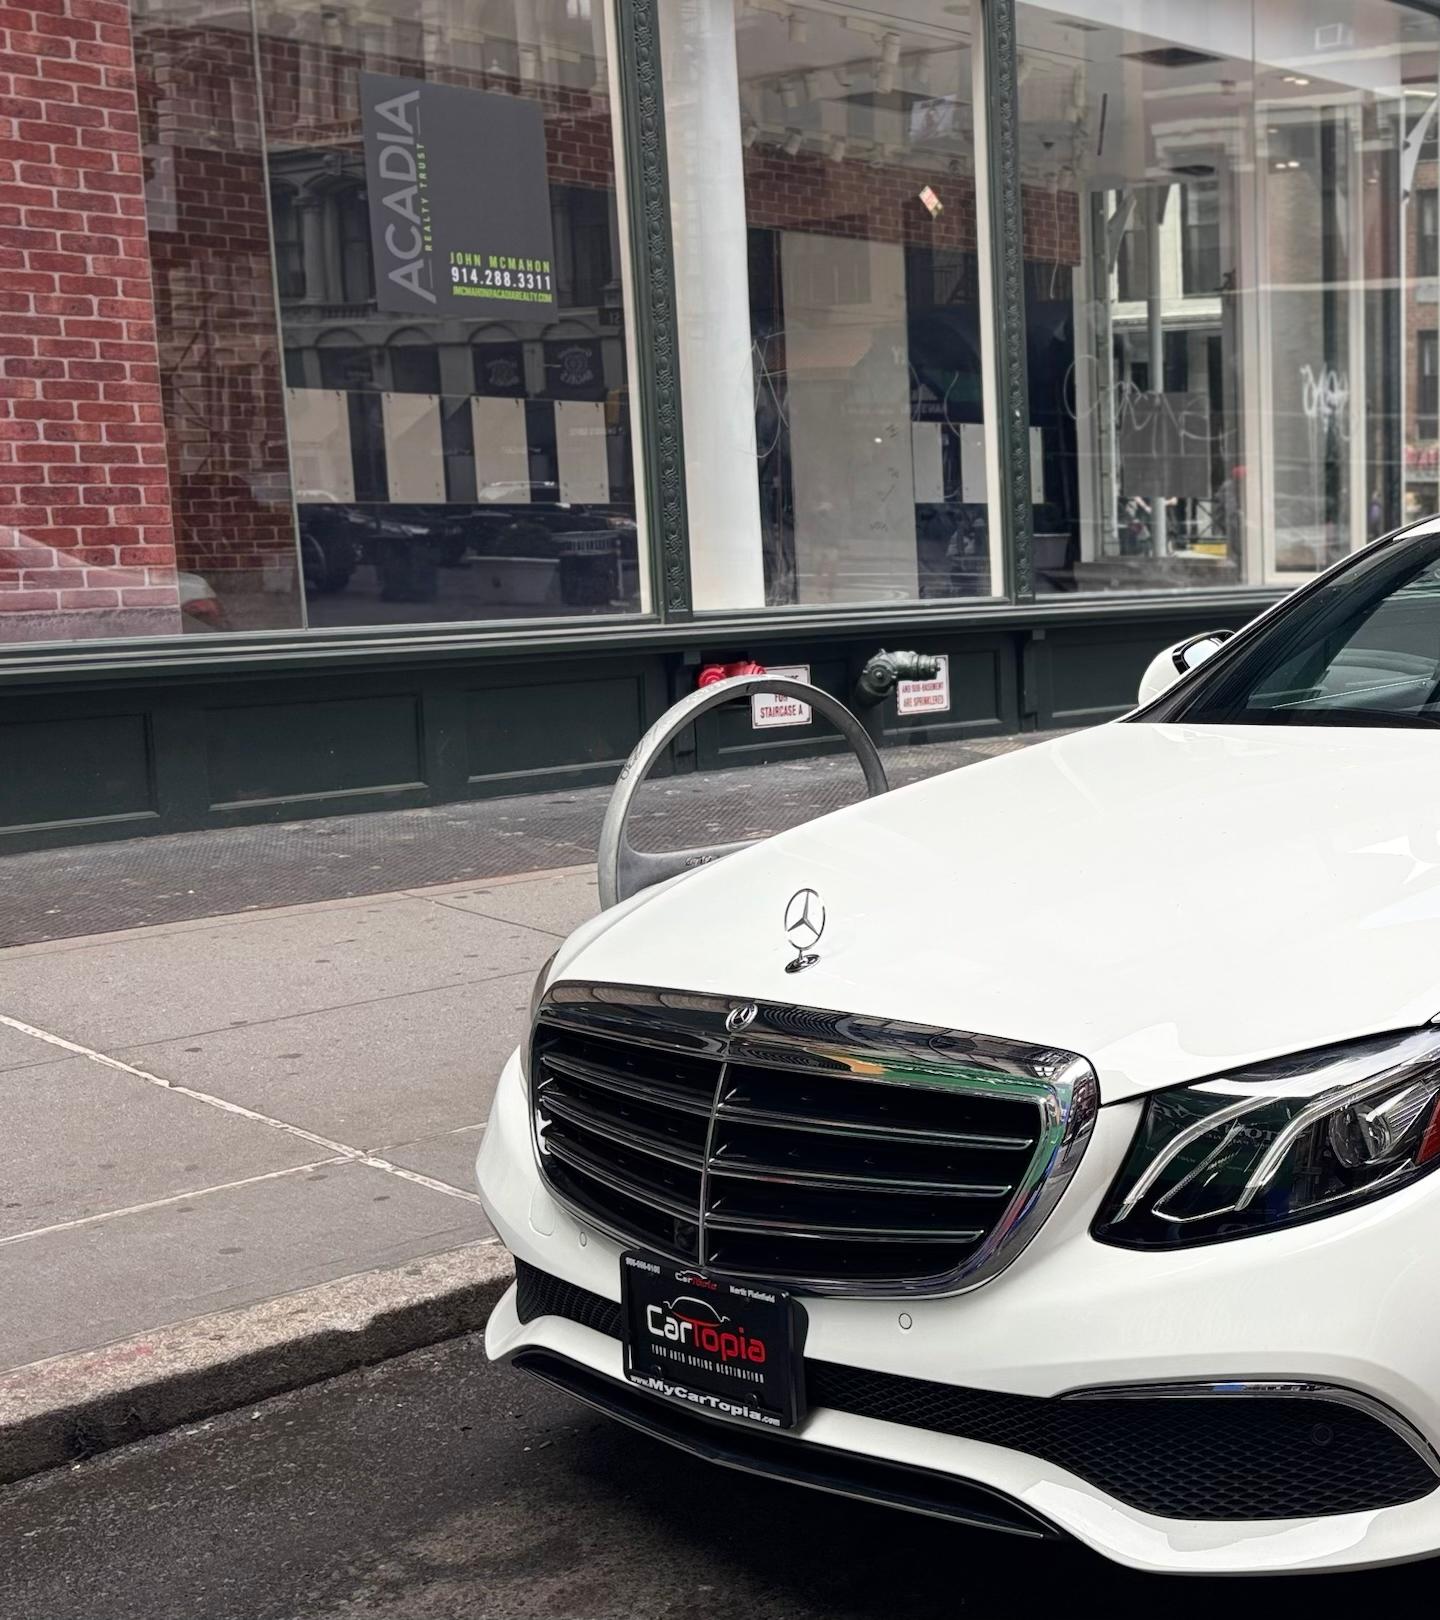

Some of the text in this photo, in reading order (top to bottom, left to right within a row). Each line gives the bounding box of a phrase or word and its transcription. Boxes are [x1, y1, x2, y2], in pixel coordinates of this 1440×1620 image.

[374, 90, 437, 304] ACADIA
[416, 142, 433, 252] REALTY TRUST
[450, 251, 550, 273] JOHN MCMAHON
[451, 266, 551, 290] 914.288.3311
[760, 703, 804, 719] STAIRCASE A
[646, 1304, 766, 1362] CarTopia
[651, 1343, 764, 1384] YOUR AUTO BUYING DESTINATION
[630, 1374, 781, 1427] www.MyCarTopia.com
